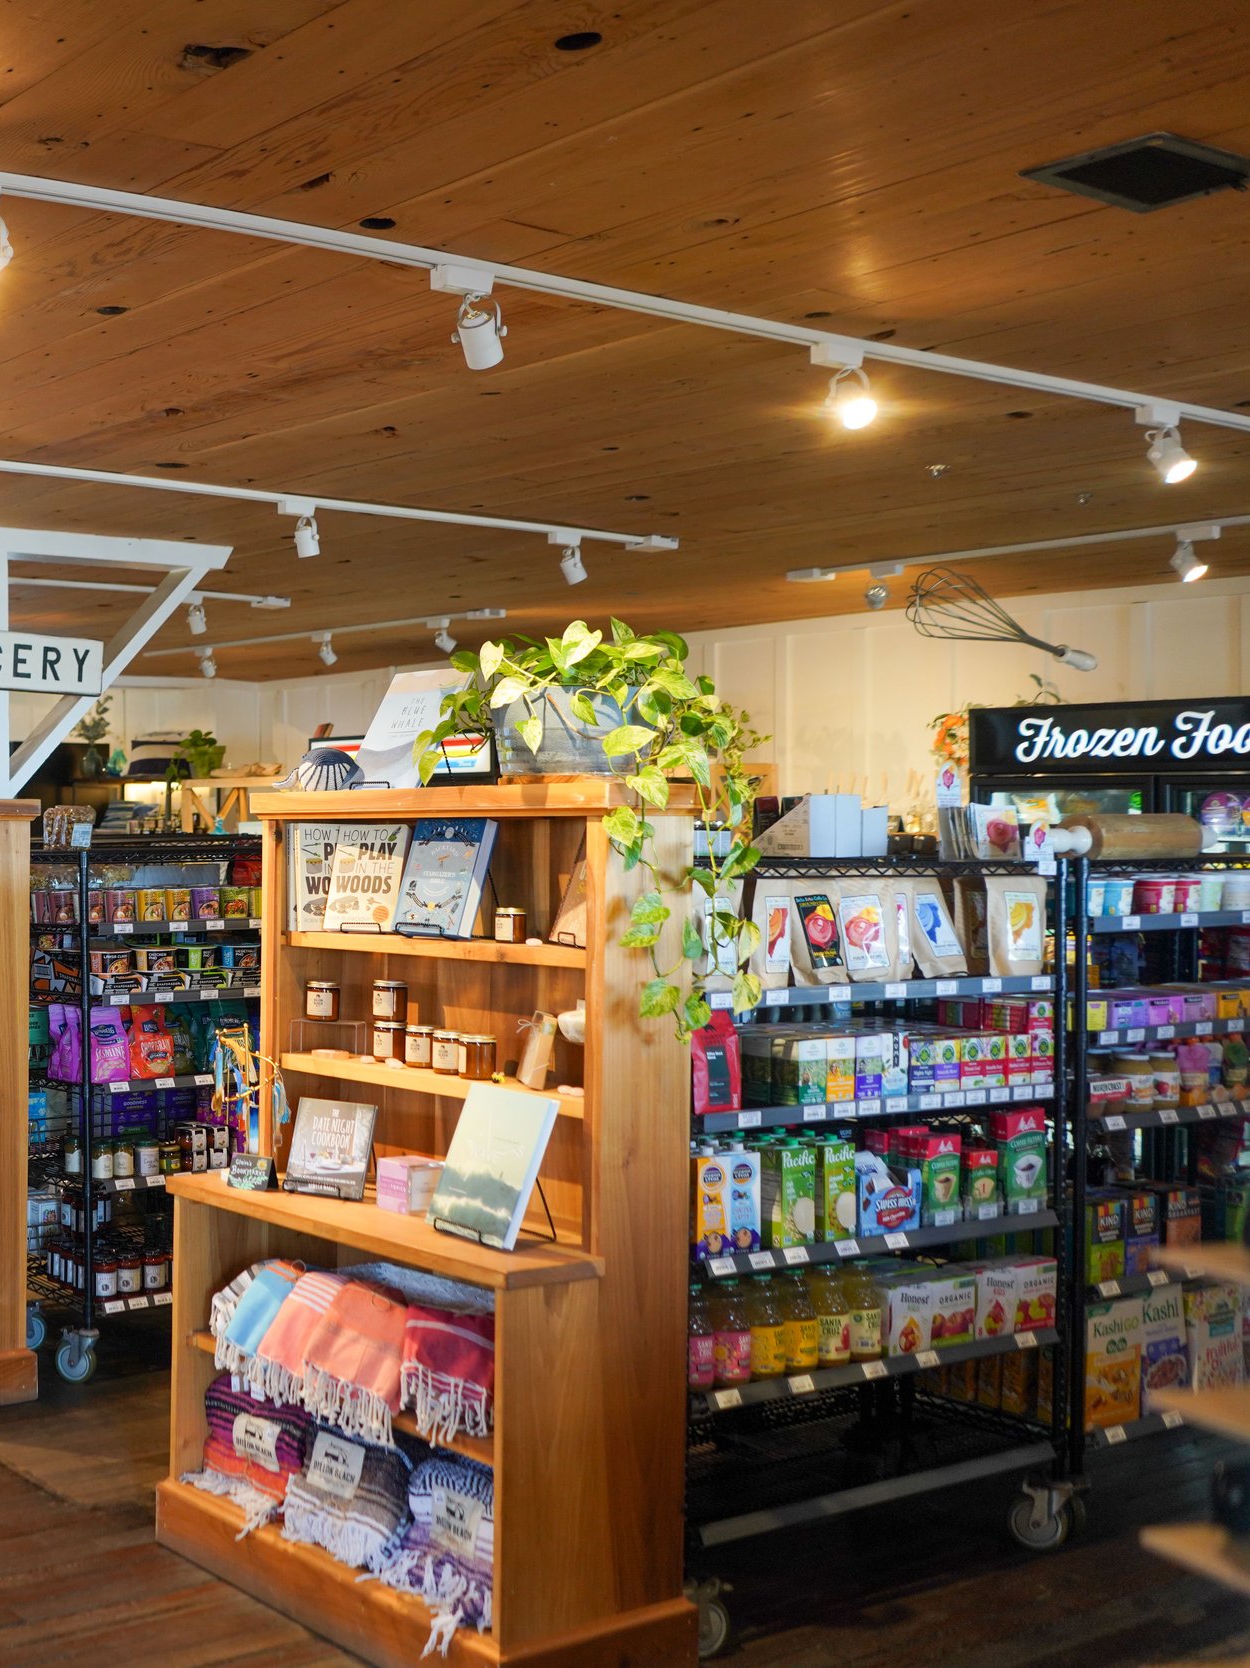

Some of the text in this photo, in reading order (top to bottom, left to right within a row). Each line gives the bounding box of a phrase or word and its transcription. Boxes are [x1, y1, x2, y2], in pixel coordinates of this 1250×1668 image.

[411, 697, 426, 705] THE
[402, 705, 427, 716] BLUE
[390, 718, 424, 729] WHALE
[1014, 716, 1166, 764] Frozen
[304, 828, 333, 840] HOW
[343, 828, 389, 841] HOW TO
[357, 842, 398, 860] PLAY
[354, 862, 395, 874] IN THE
[335, 875, 393, 894] WOODS
[95, 1045, 126, 1061] JASMINE
[332, 1108, 341, 1117] THE
[313, 1116, 356, 1133] DATE NIGHT
[311, 1131, 351, 1149] COOKBOOK
[782, 1149, 815, 1168] Pacific
[824, 1145, 855, 1164] Pacific
[875, 1199, 897, 1212] SWISS
[1168, 1200, 1187, 1211] KIND
[1135, 1208, 1154, 1219] KIND
[1100, 1215, 1119, 1226] KIND
[986, 1277, 1015, 1289] Honest
[1023, 1277, 1055, 1289] ORGANIC
[901, 1293, 931, 1305] Honest
[939, 1294, 972, 1305] ORGANIC
[1142, 1296, 1180, 1325] Kashi
[820, 1318, 842, 1328] SANTA
[1093, 1316, 1140, 1338] Kashi GO
[821, 1326, 841, 1337] CRUZ
[313, 1460, 356, 1484] DILLON BEACH
